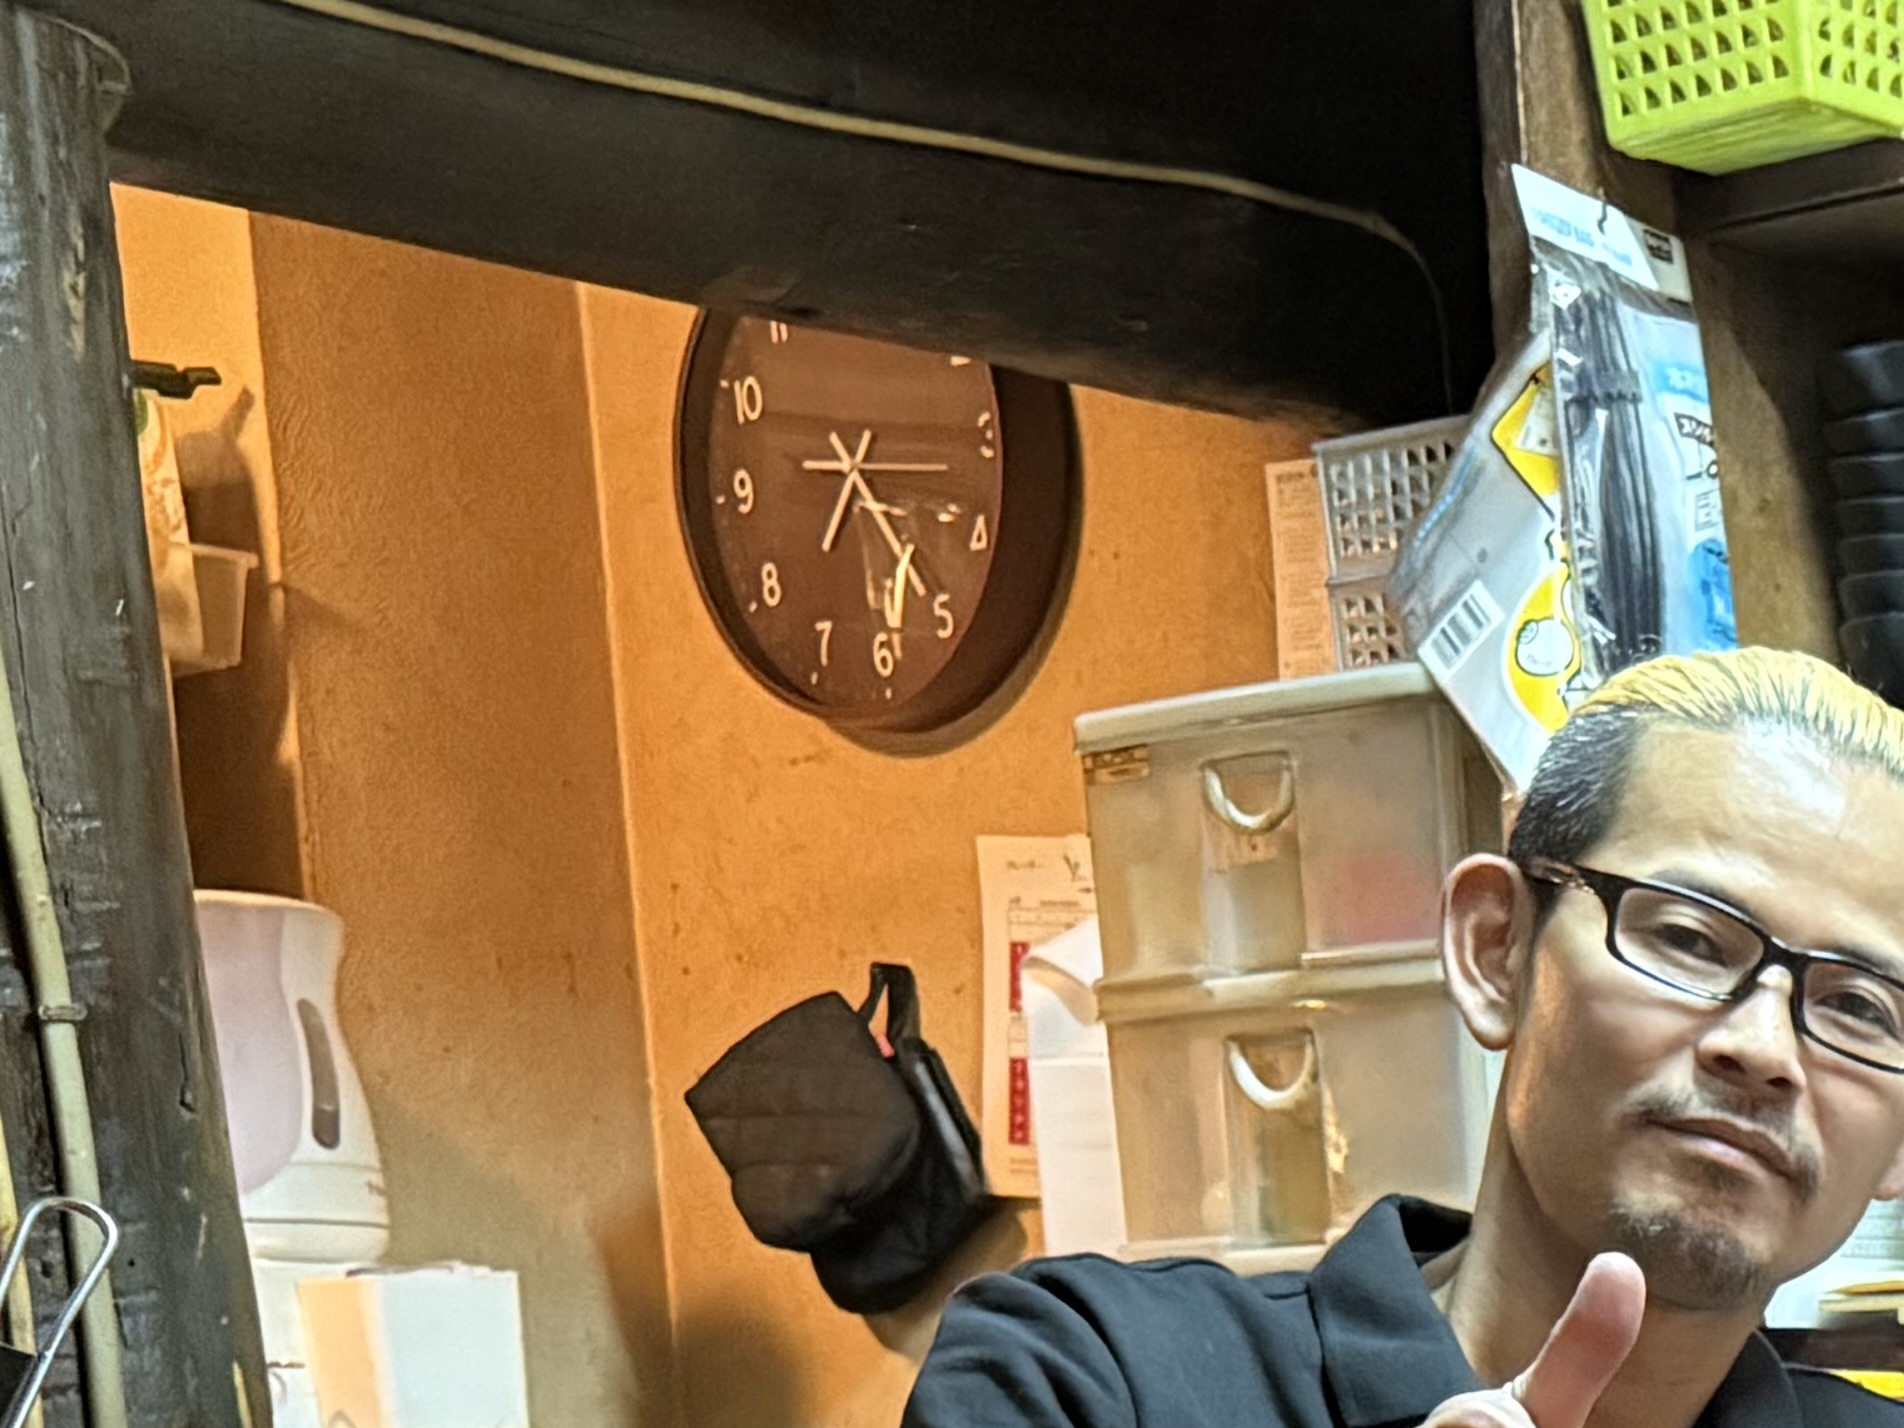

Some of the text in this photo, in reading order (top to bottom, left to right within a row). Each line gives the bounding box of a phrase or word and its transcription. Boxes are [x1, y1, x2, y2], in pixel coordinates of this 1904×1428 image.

[733, 375, 764, 423] 10
[732, 468, 755, 514] 9
[760, 561, 782, 607] 8
[932, 593, 954, 640] 5
[815, 620, 834, 666] 7
[872, 632, 895, 679] 6
